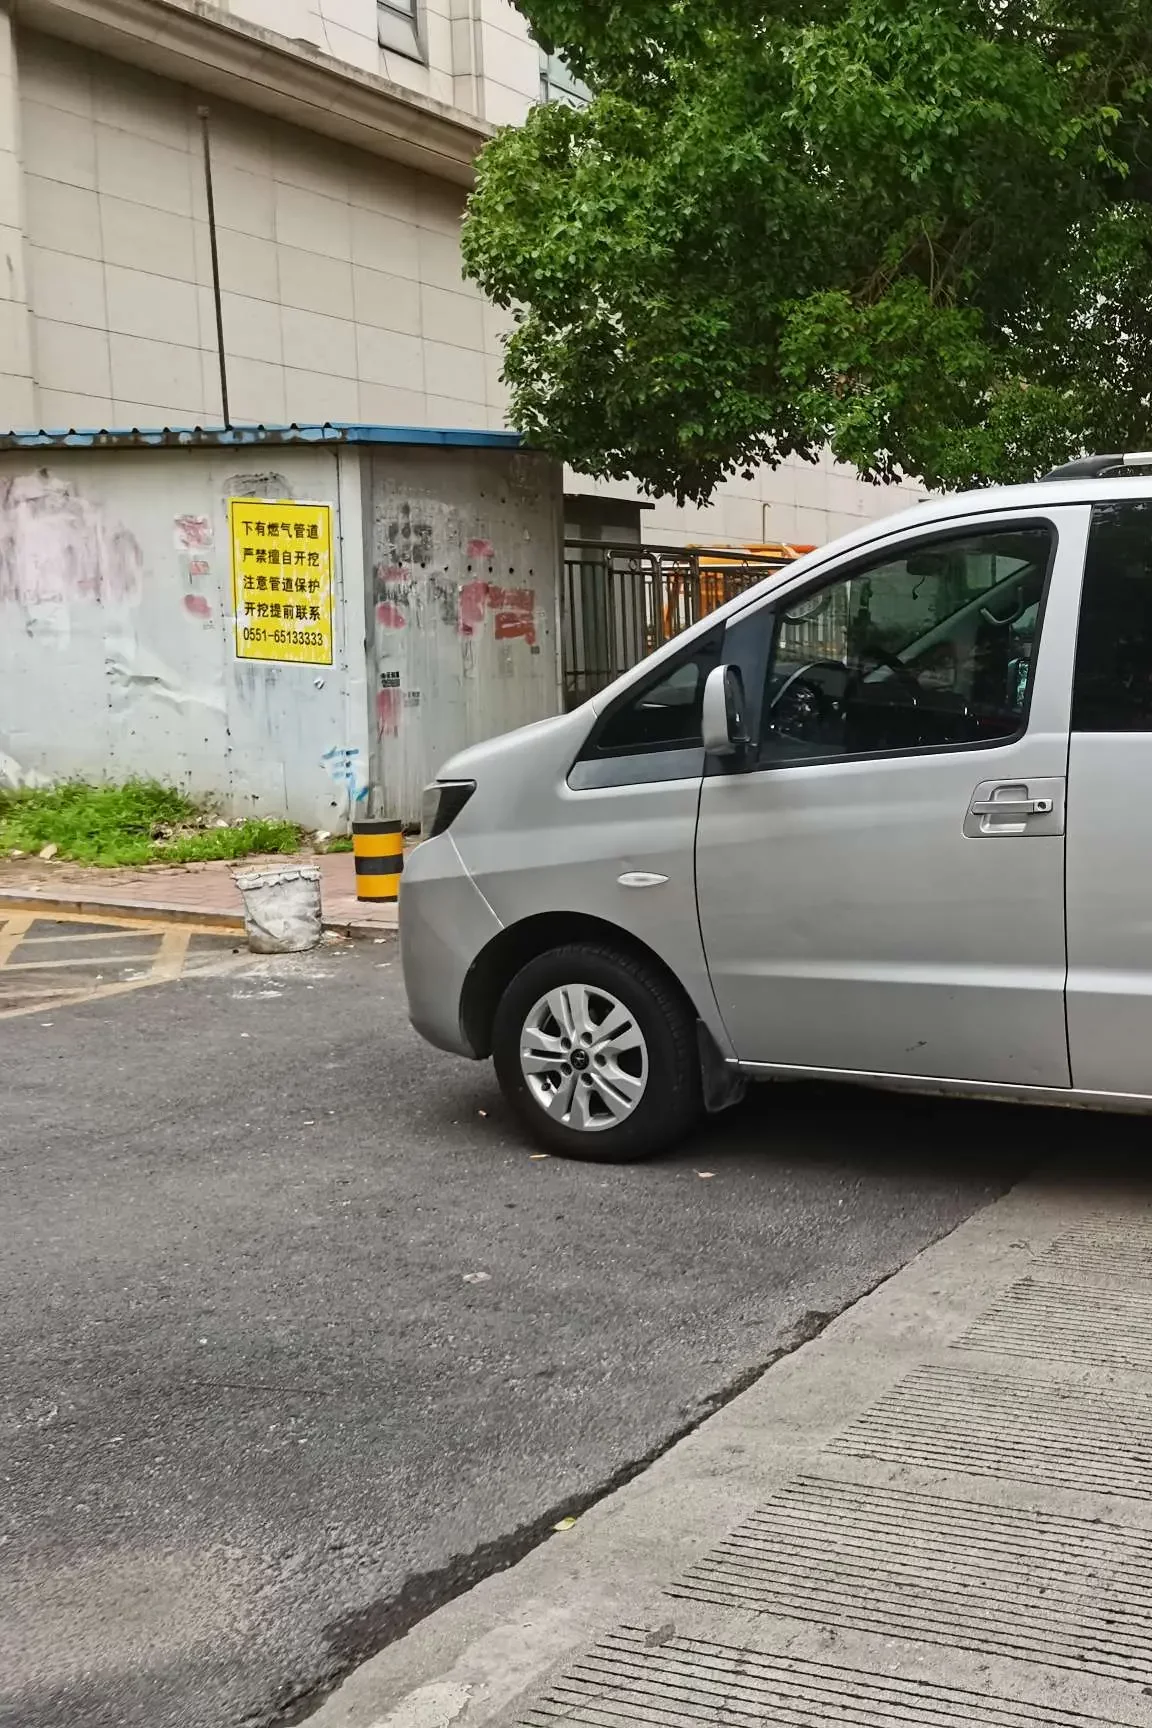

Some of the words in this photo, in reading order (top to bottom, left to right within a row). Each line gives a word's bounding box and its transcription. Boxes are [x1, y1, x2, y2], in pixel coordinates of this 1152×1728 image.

[241, 520, 319, 540] 下有燃气管道
[242, 547, 320, 567] 严禁擅自开挖
[243, 574, 320, 594] 注意管道保护
[244, 601, 321, 621] 开挖提前联系
[243, 626, 324, 647] 0551-65133333
